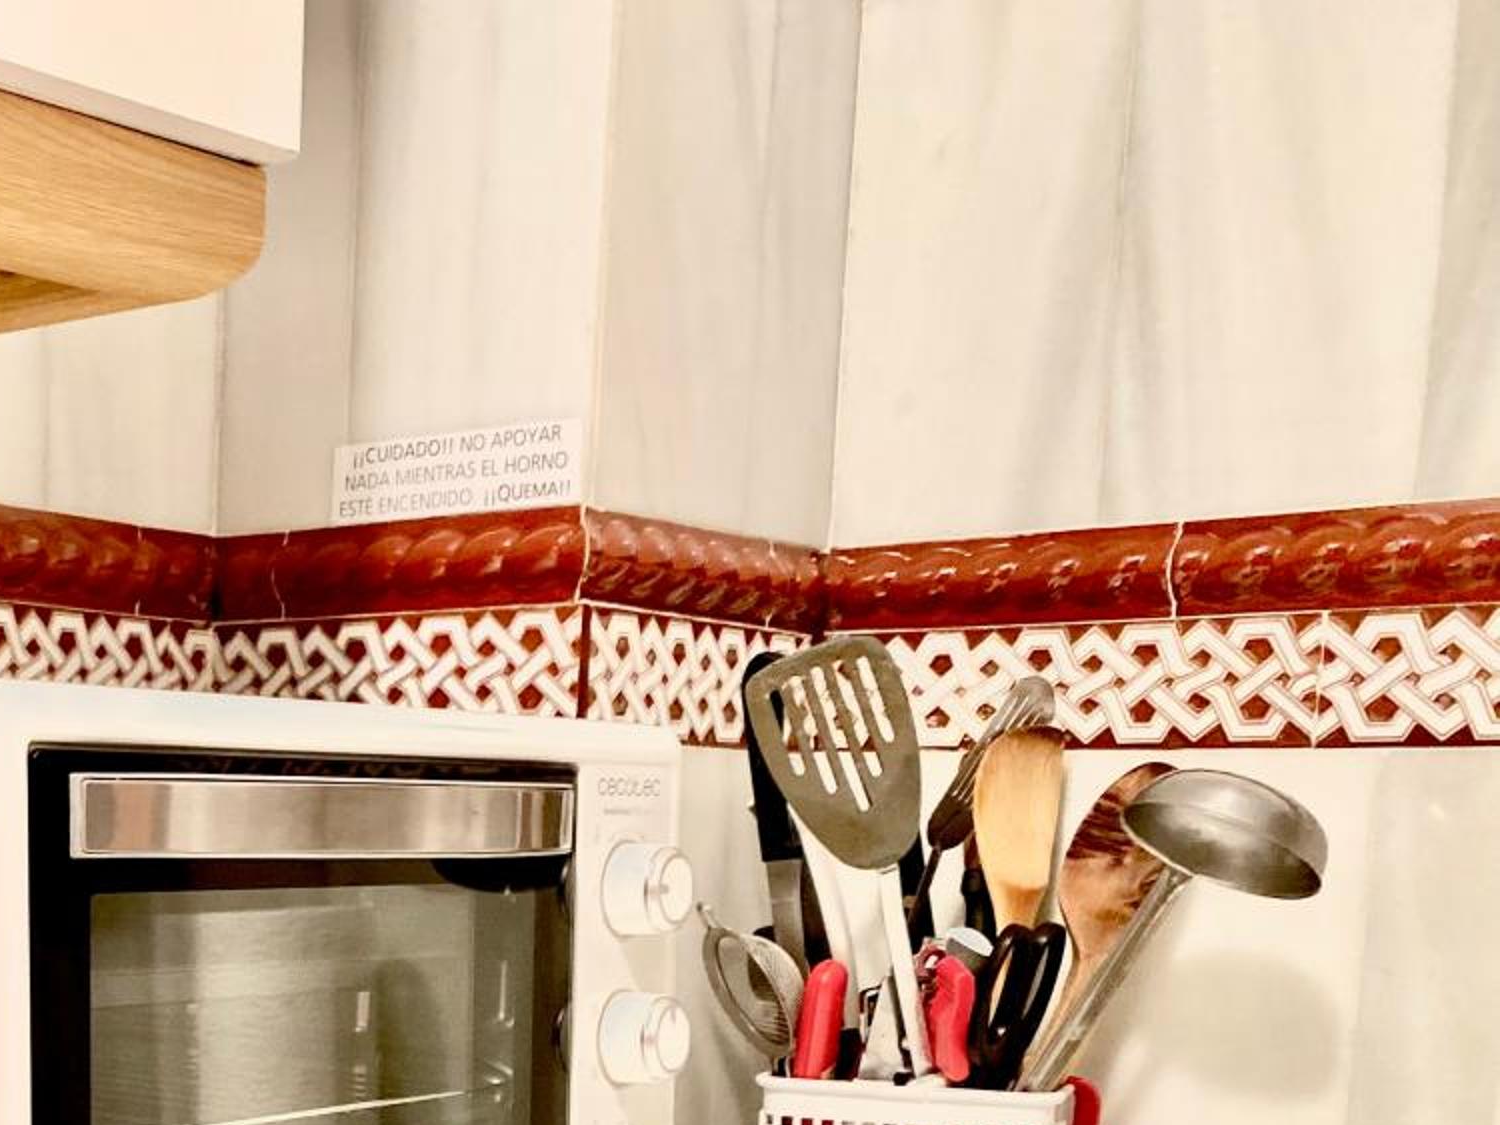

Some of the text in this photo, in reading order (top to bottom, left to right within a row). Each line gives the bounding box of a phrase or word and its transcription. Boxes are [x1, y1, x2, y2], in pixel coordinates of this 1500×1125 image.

[459, 433, 486, 452] NO
[491, 424, 562, 449] APOYAR
[345, 451, 569, 491] NADA MIENTRAS EL HORNO
[380, 487, 473, 514] ENCENDIDO
